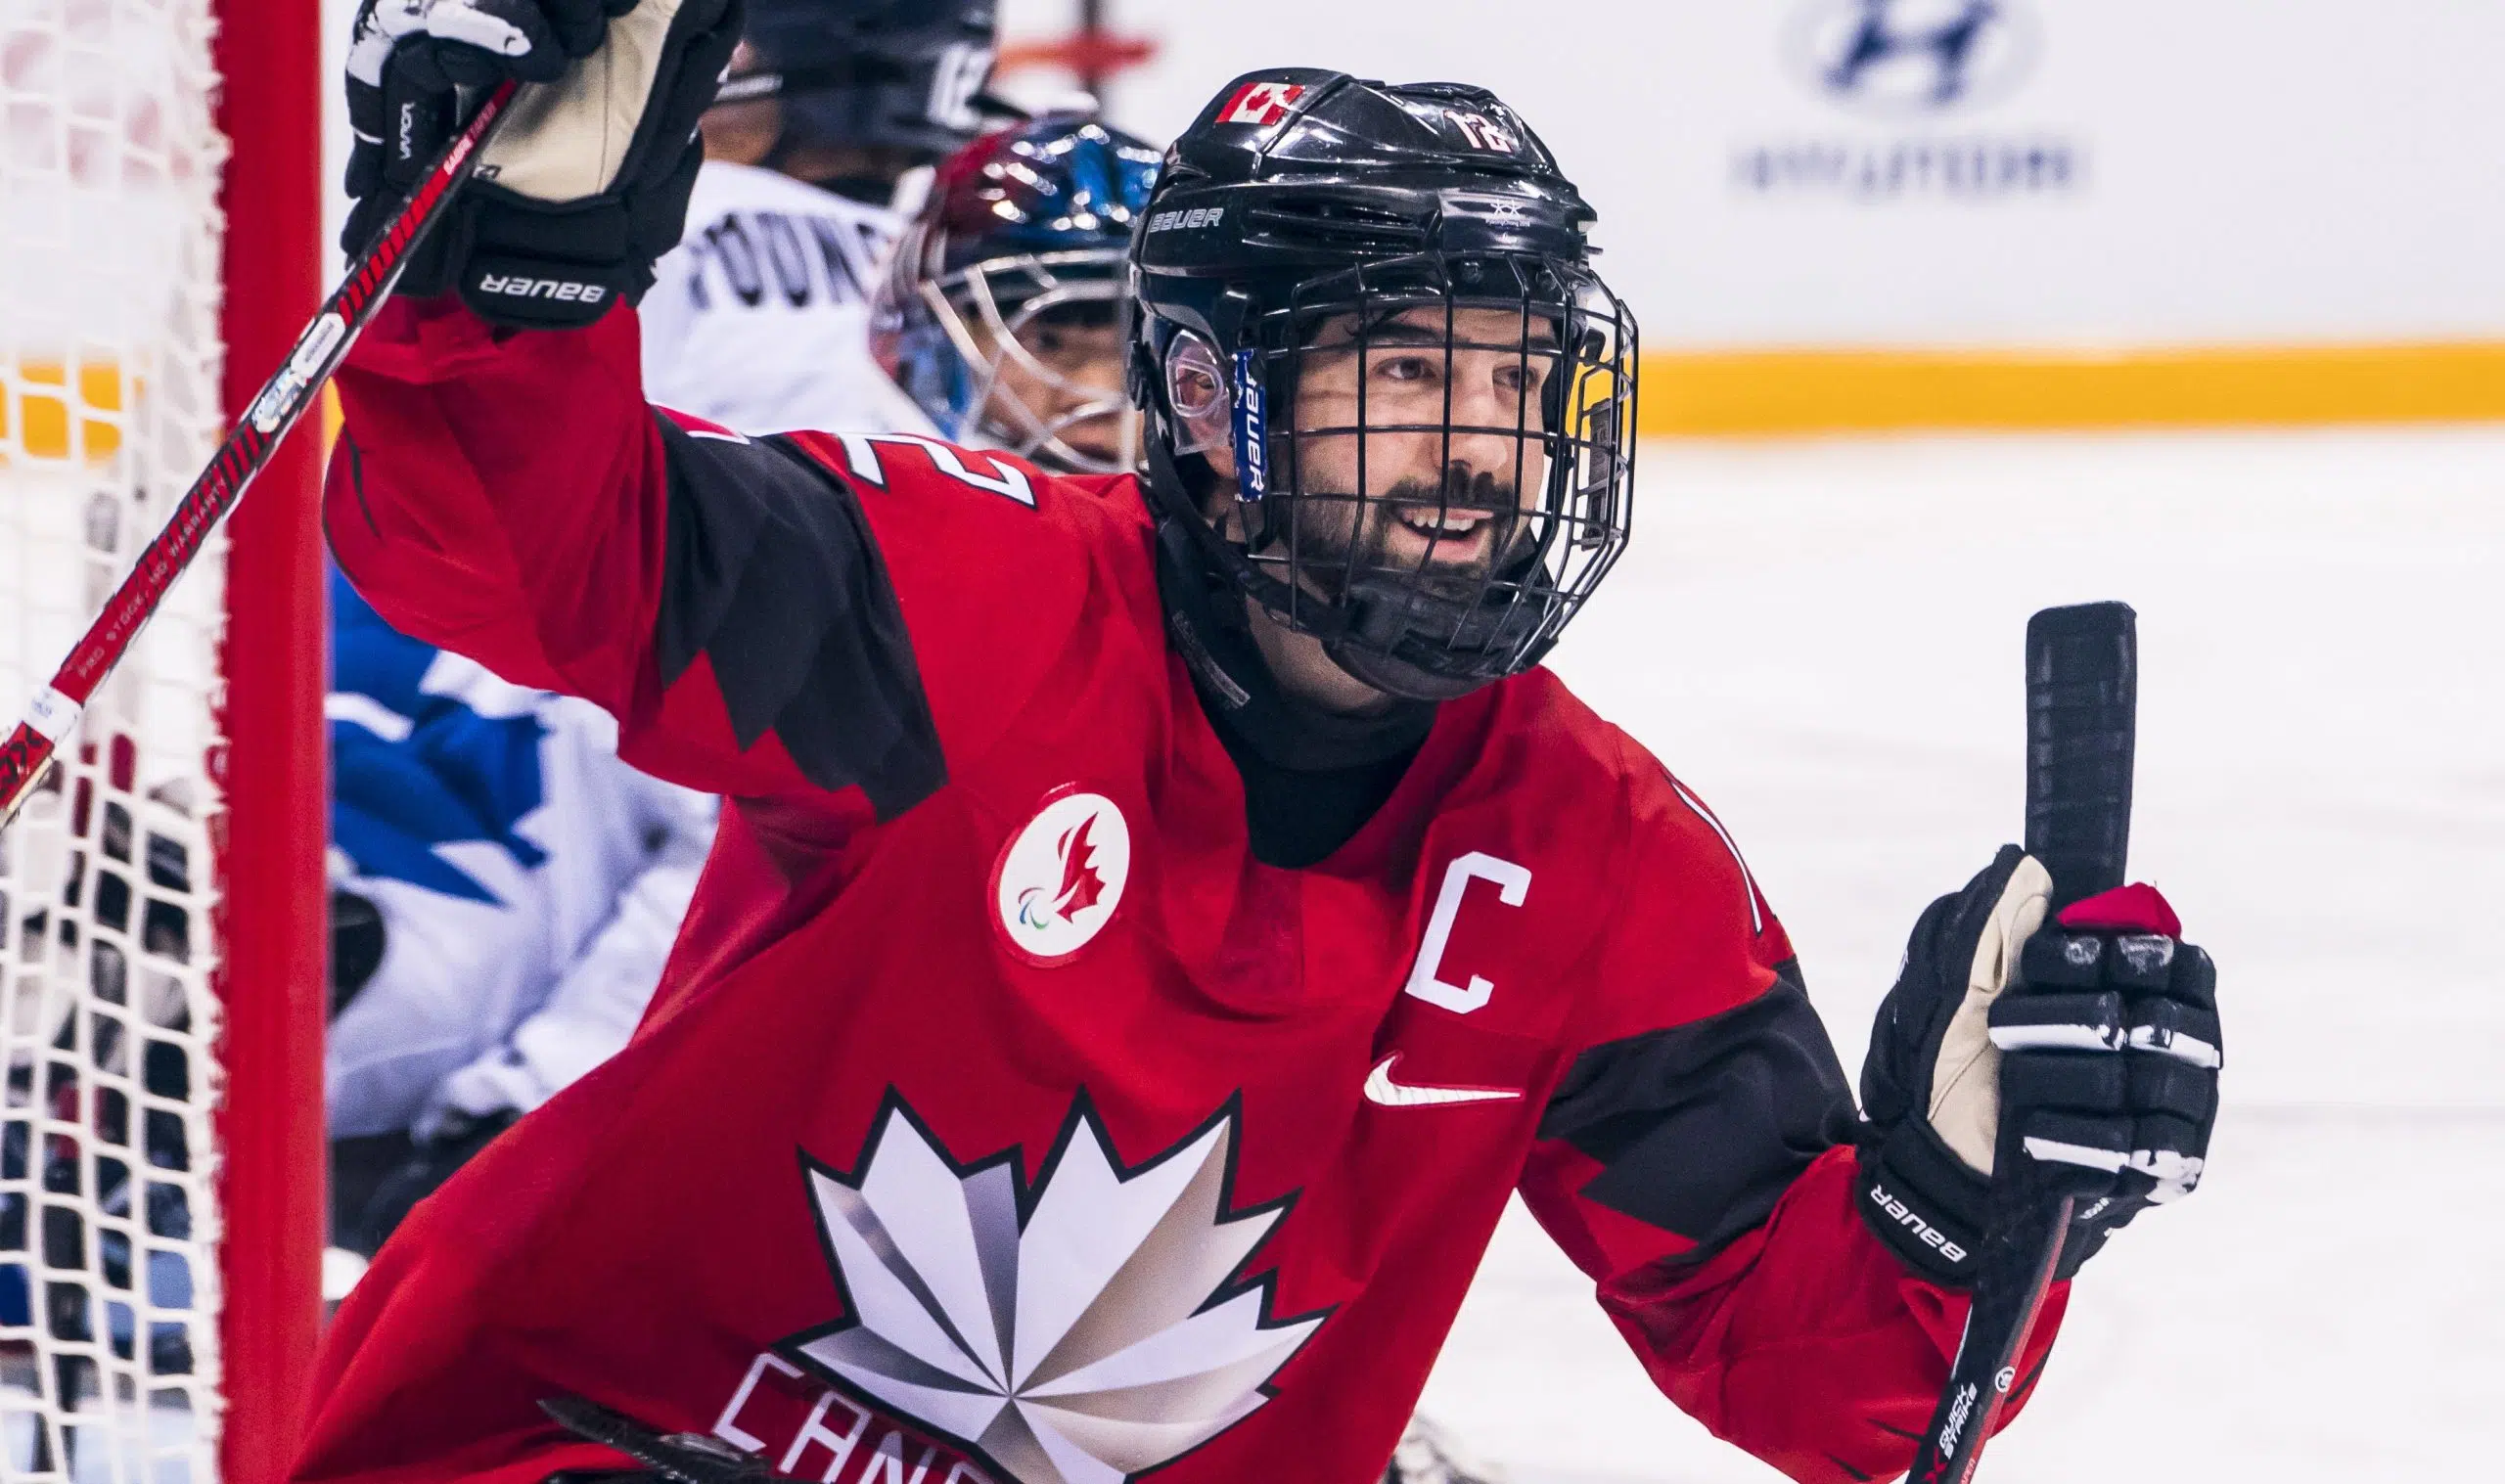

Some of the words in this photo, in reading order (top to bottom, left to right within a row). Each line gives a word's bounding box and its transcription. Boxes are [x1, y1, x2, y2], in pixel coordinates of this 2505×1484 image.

[1149, 207, 1224, 234] BAUER
[479, 273, 607, 303] BAUER
[1404, 850, 1532, 1014] C
[1870, 1184, 1967, 1263] BAUER
[711, 1352, 996, 1484] CAN
